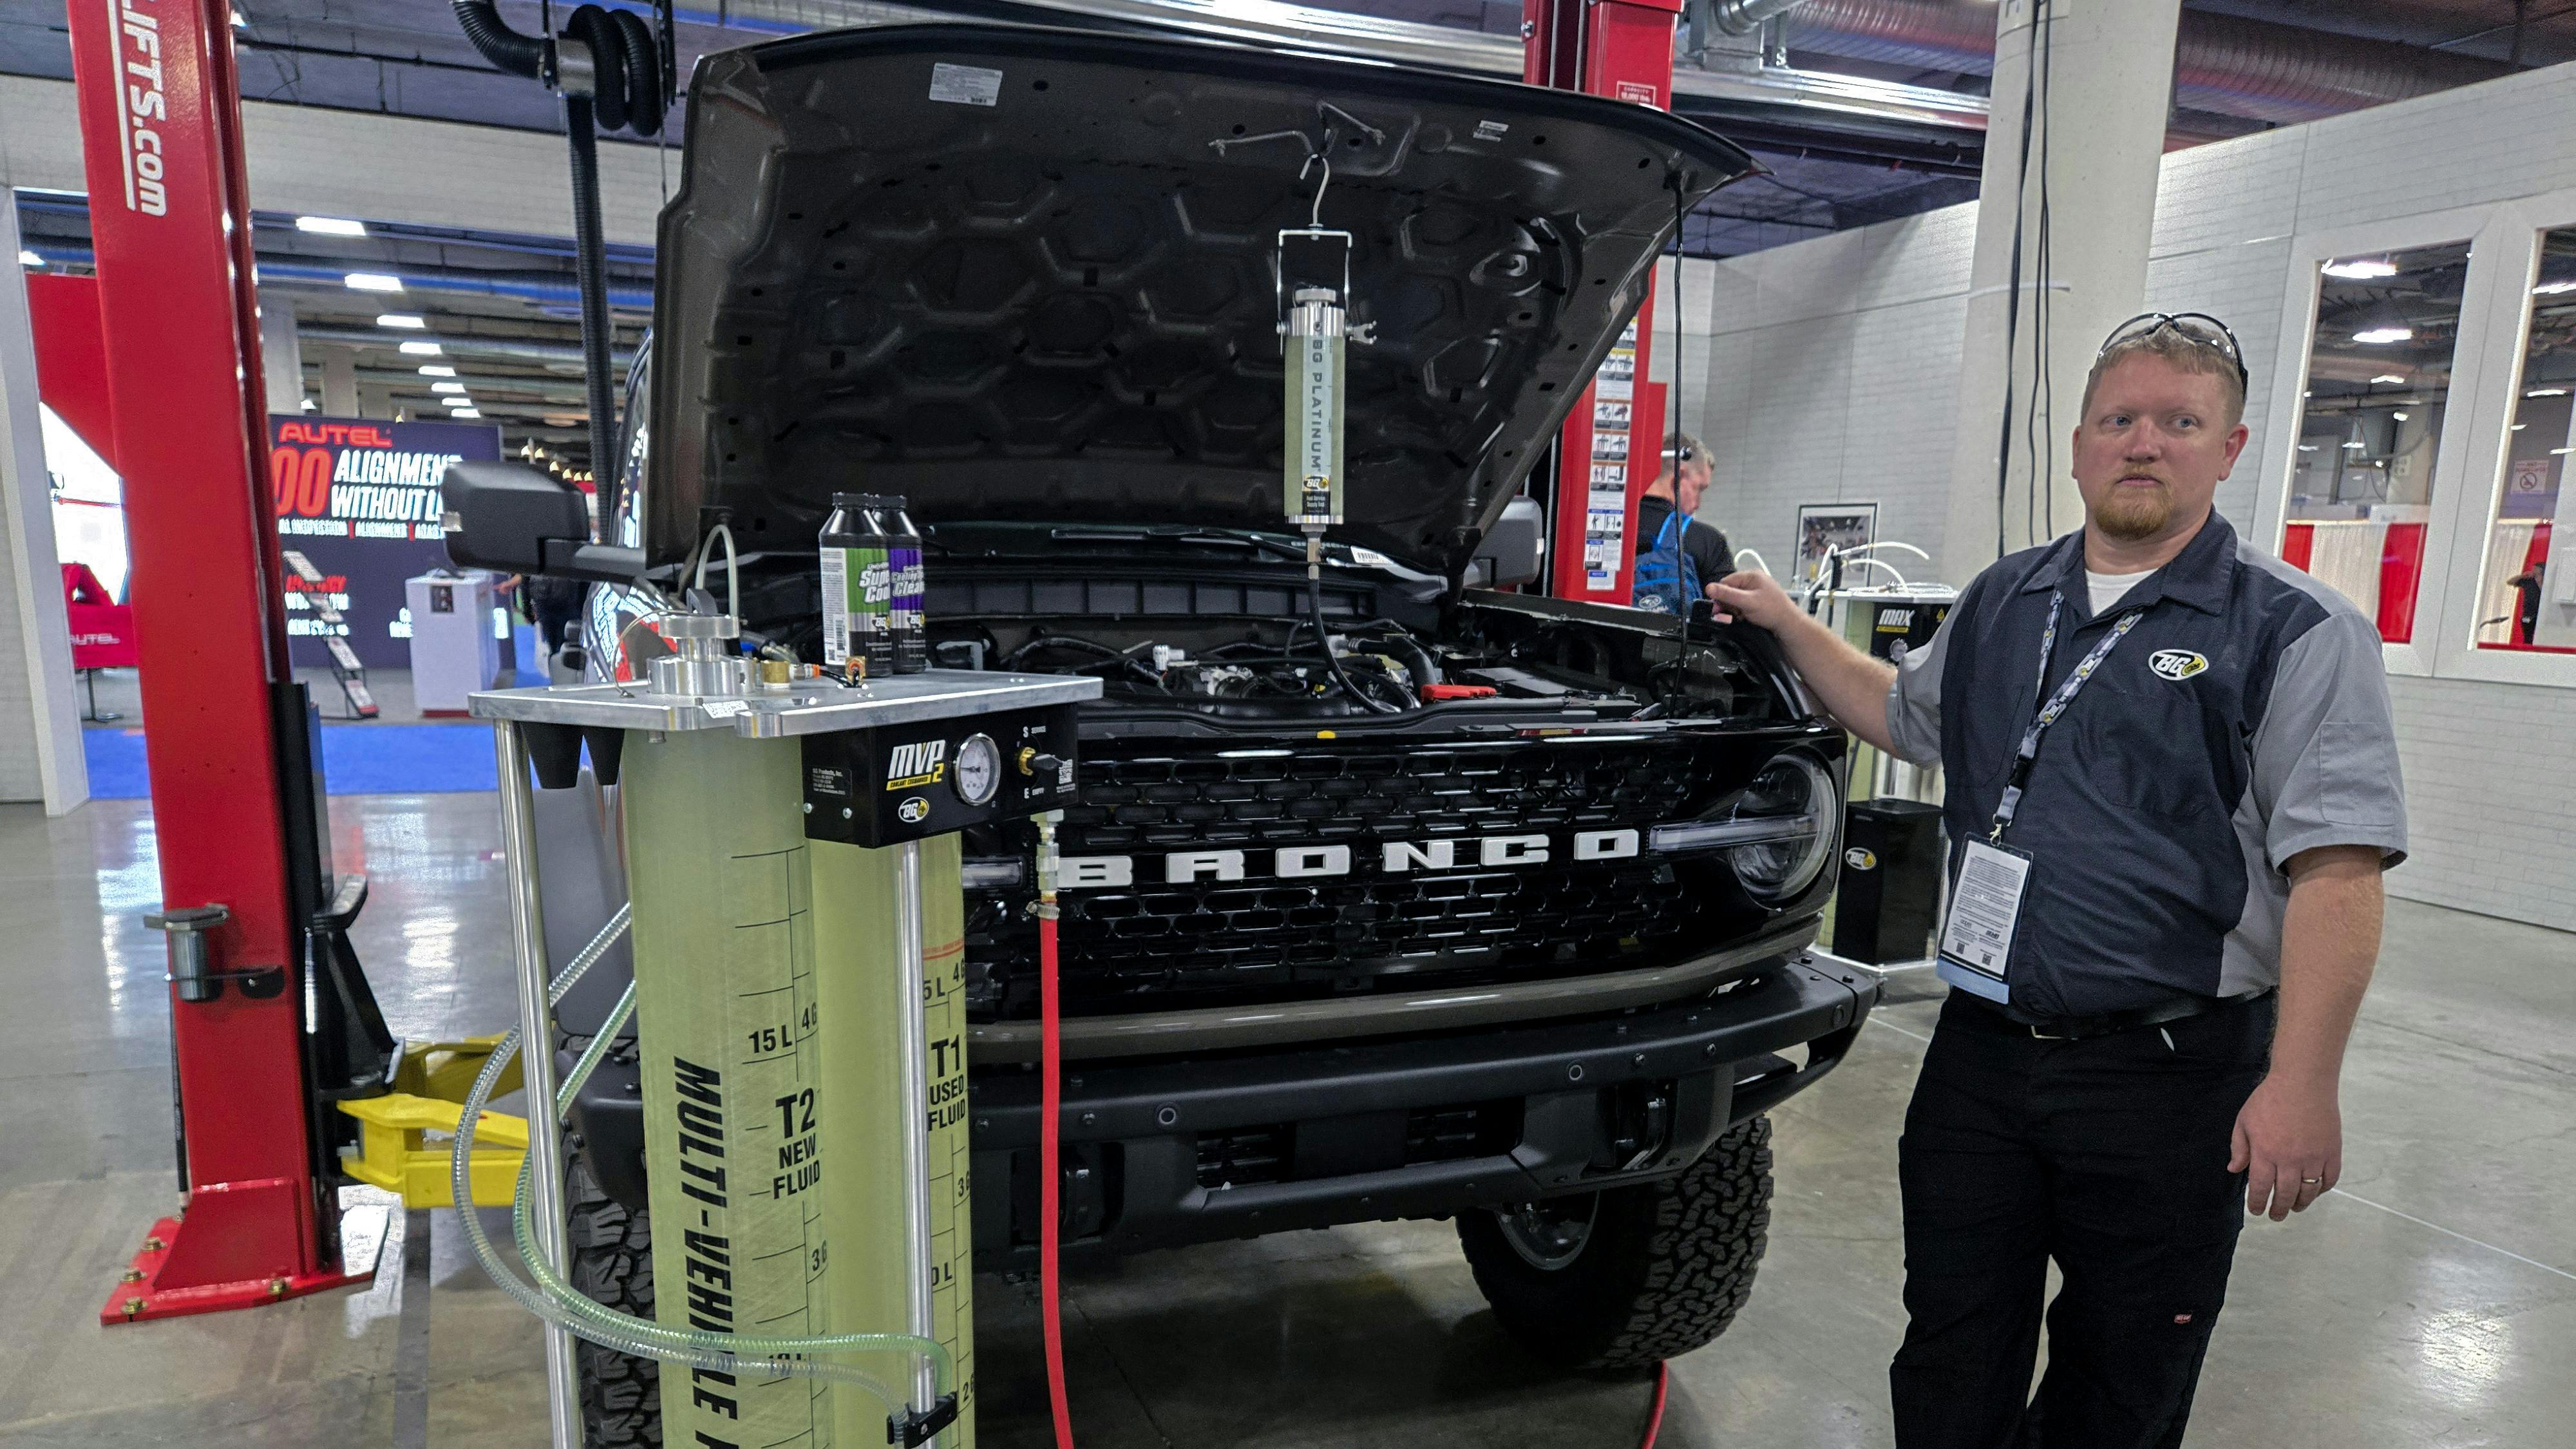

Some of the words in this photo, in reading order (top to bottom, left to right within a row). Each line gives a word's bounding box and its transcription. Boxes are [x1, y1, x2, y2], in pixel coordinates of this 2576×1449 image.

[279, 422, 392, 447] AUTEL
[1311, 372, 1323, 471] PLATINUM
[331, 485, 428, 520] WITHOUT
[1879, 609, 1916, 627] MAX
[2155, 654, 2192, 674] BG
[1023, 726, 1028, 738] S
[888, 740, 945, 779] MVP
[932, 762, 945, 783] 2
[902, 802, 919, 819] BG
[1024, 788, 1029, 799] E
[1057, 828, 1640, 889] BRONCO
[931, 1034, 960, 1078] T1
[929, 1074, 964, 1105] USED
[775, 1088, 816, 1139] T2
[927, 1098, 965, 1132] FLUID
[778, 1133, 816, 1170] NEW
[773, 1160, 820, 1200] FLUID
[674, 1056, 739, 1421] MULTI-VEHILE
